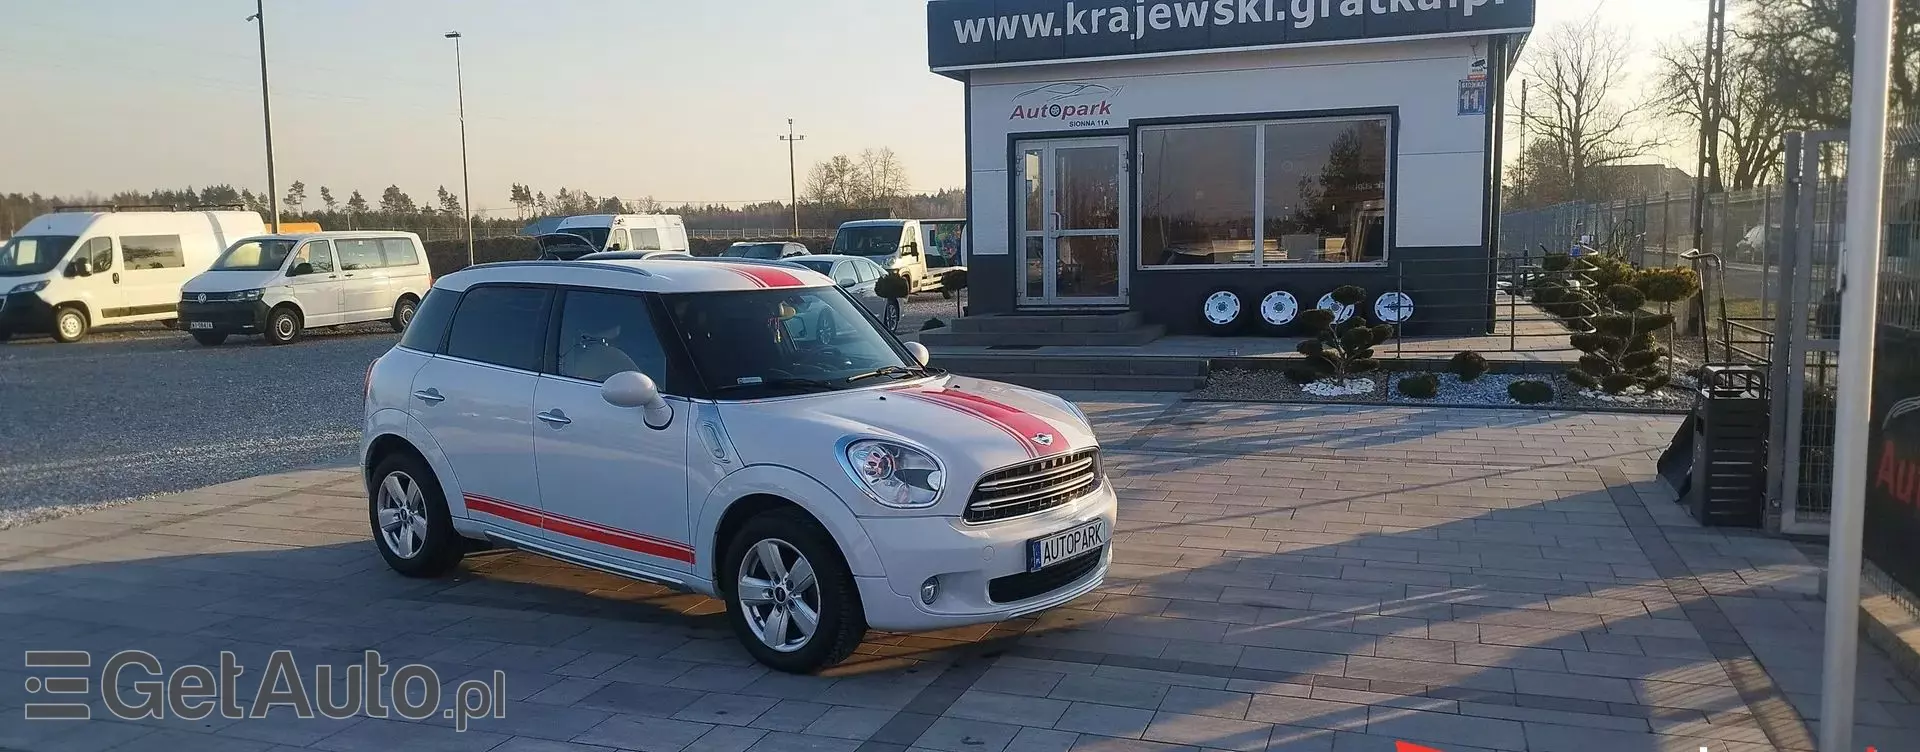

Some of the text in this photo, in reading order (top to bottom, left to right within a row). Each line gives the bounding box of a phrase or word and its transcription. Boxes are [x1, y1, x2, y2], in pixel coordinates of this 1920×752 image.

[954, 0, 1500, 44] www.krajewski.gra.
[1009, 100, 1112, 120] Autopark
[1069, 119, 1109, 128] SIONNA 11A
[1875, 440, 1920, 508] Au
[1043, 523, 1103, 564] AUTOPARK
